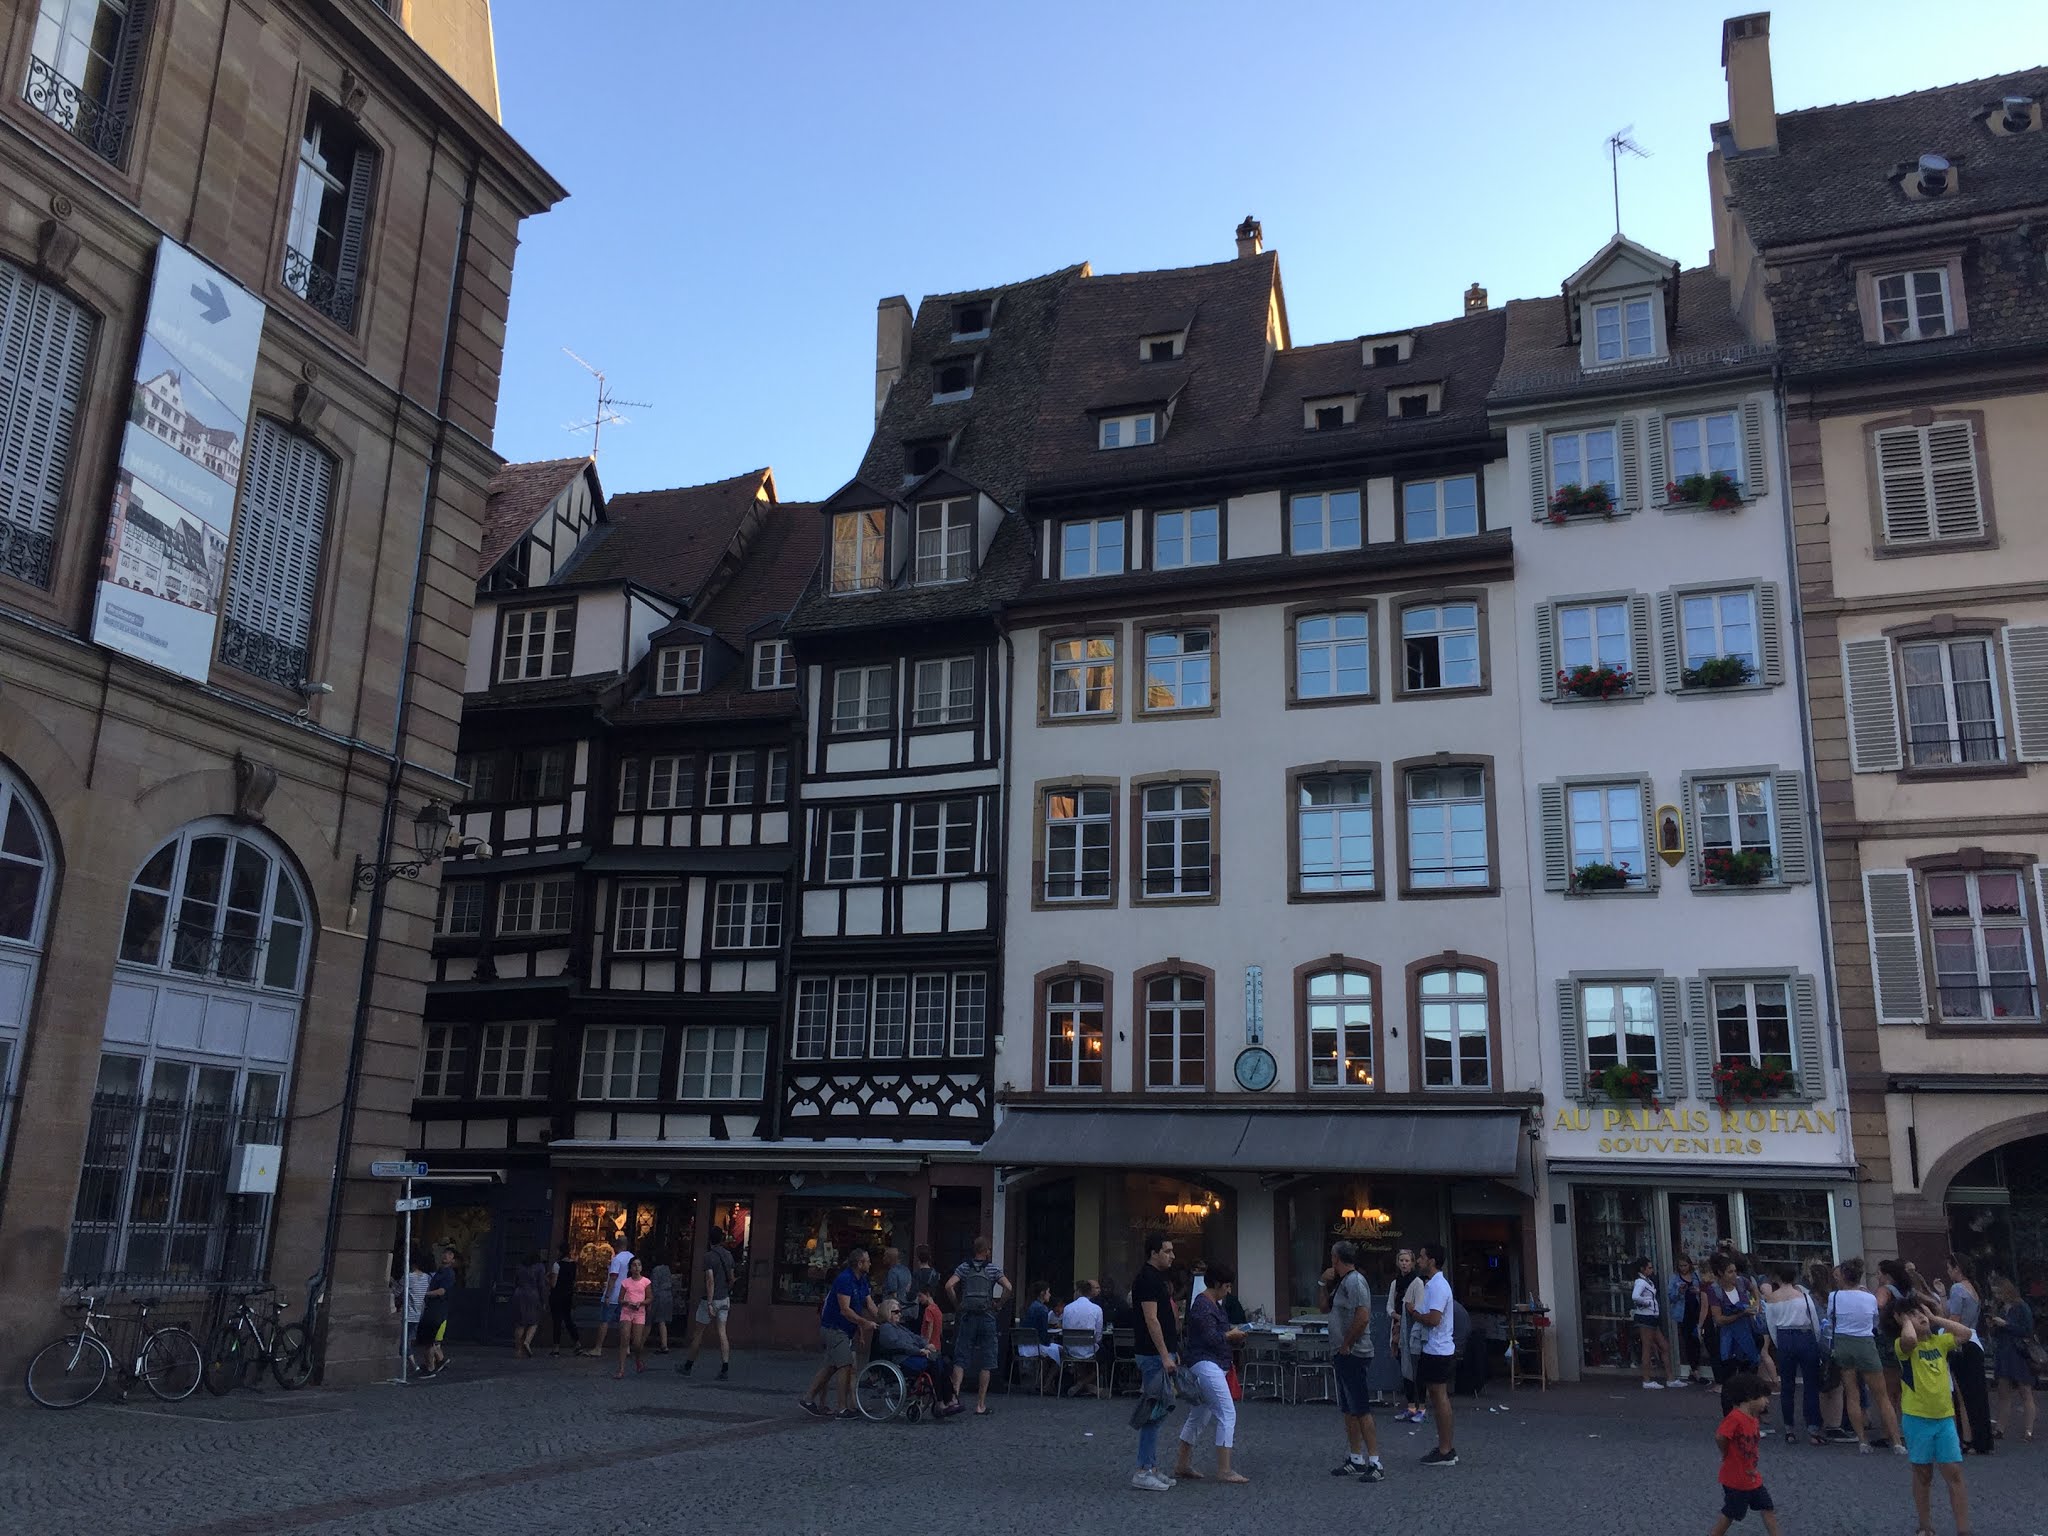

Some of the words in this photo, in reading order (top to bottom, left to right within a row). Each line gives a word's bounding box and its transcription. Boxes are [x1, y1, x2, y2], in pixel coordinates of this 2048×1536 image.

[1553, 1108, 1591, 1131] AU
[1603, 1108, 1710, 1132] PALAIS
[1720, 1109, 1837, 1134] ROHAN
[1599, 1138, 1763, 1155] SOUVENIRS
